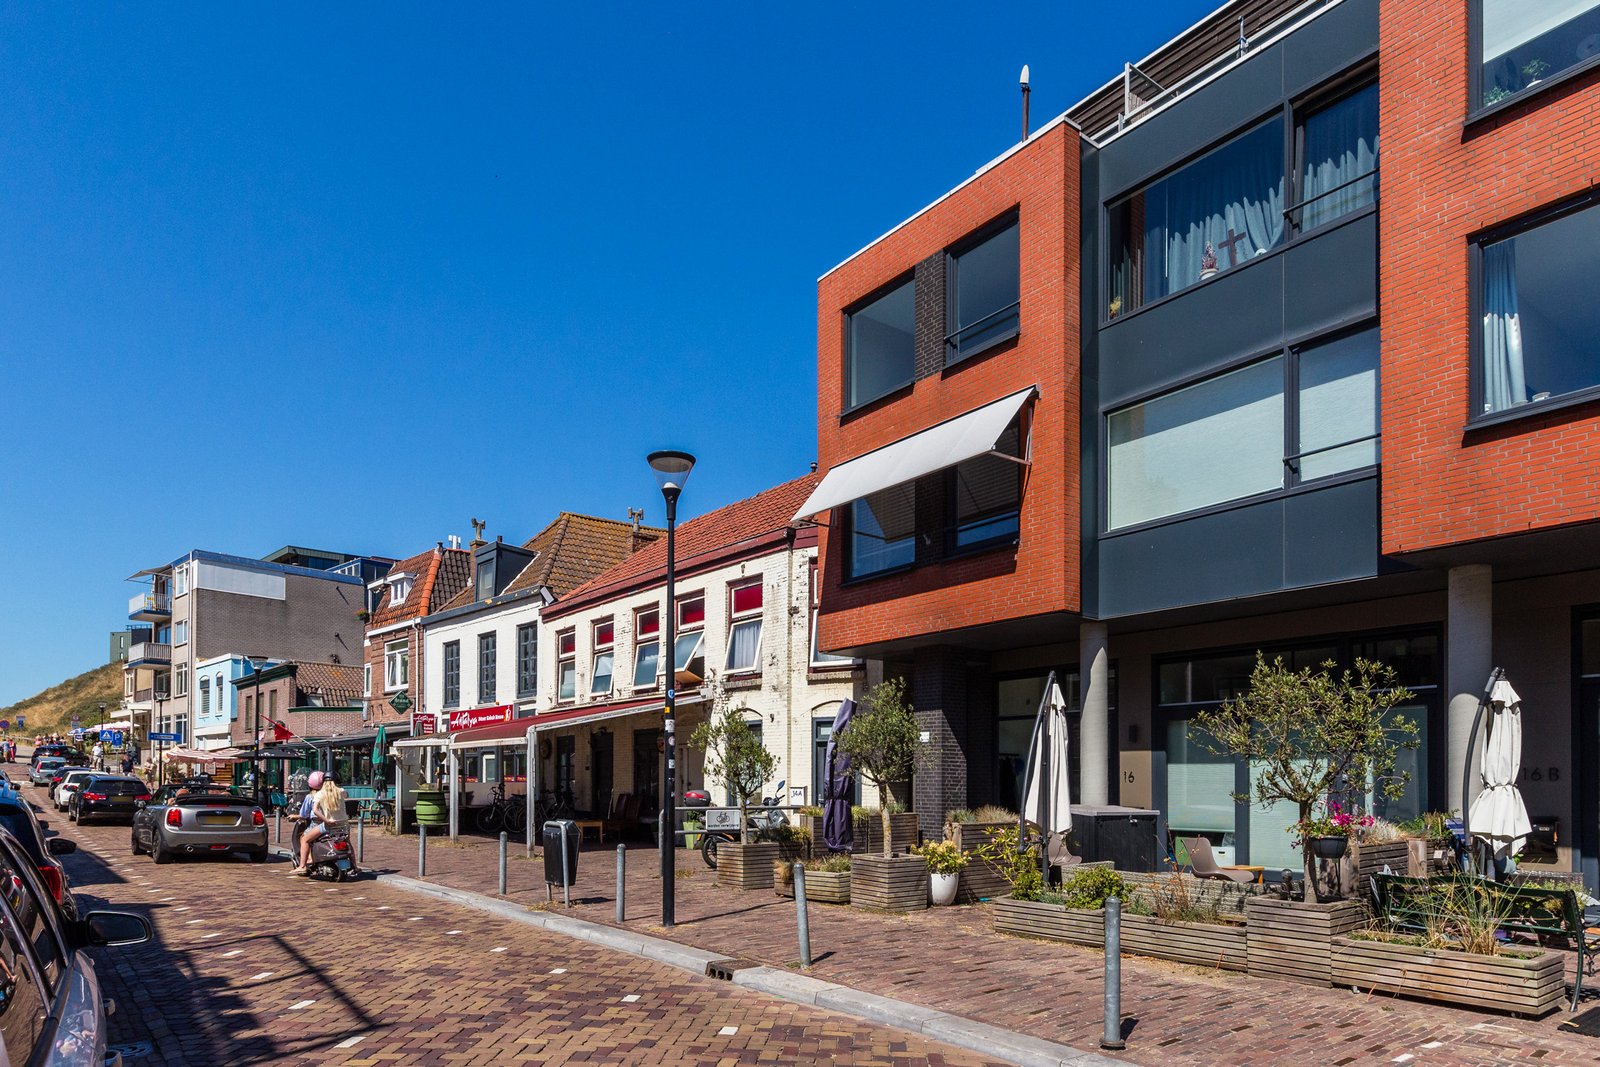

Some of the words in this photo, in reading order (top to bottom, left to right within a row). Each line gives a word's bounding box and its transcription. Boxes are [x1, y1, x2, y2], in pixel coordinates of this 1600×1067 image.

[1123, 770, 1135, 783] 16
[1523, 767, 1542, 781] 16
[1548, 767, 1560, 782] B
